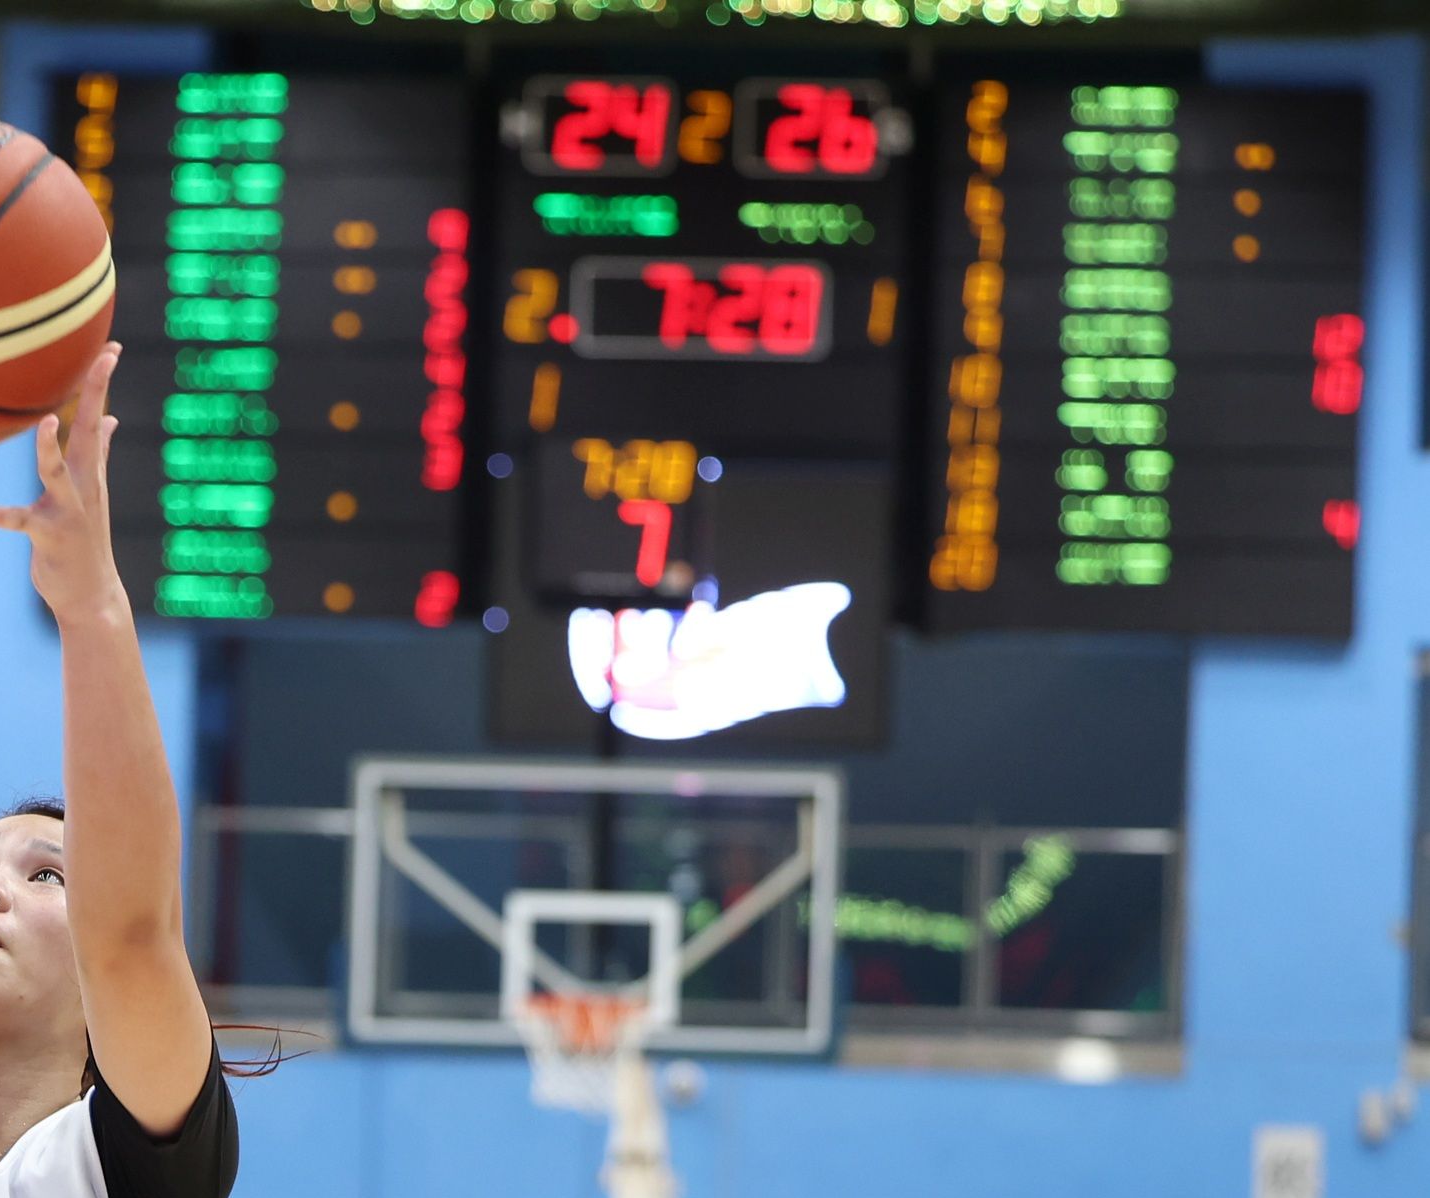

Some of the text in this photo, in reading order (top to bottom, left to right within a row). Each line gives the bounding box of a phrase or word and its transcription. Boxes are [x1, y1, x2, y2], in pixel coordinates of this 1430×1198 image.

[551, 82, 670, 170] 24
[678, 90, 732, 164] 2
[764, 84, 879, 174] 26
[503, 269, 559, 344] 2
[642, 262, 825, 355] 7:28
[617, 499, 673, 587] 7
